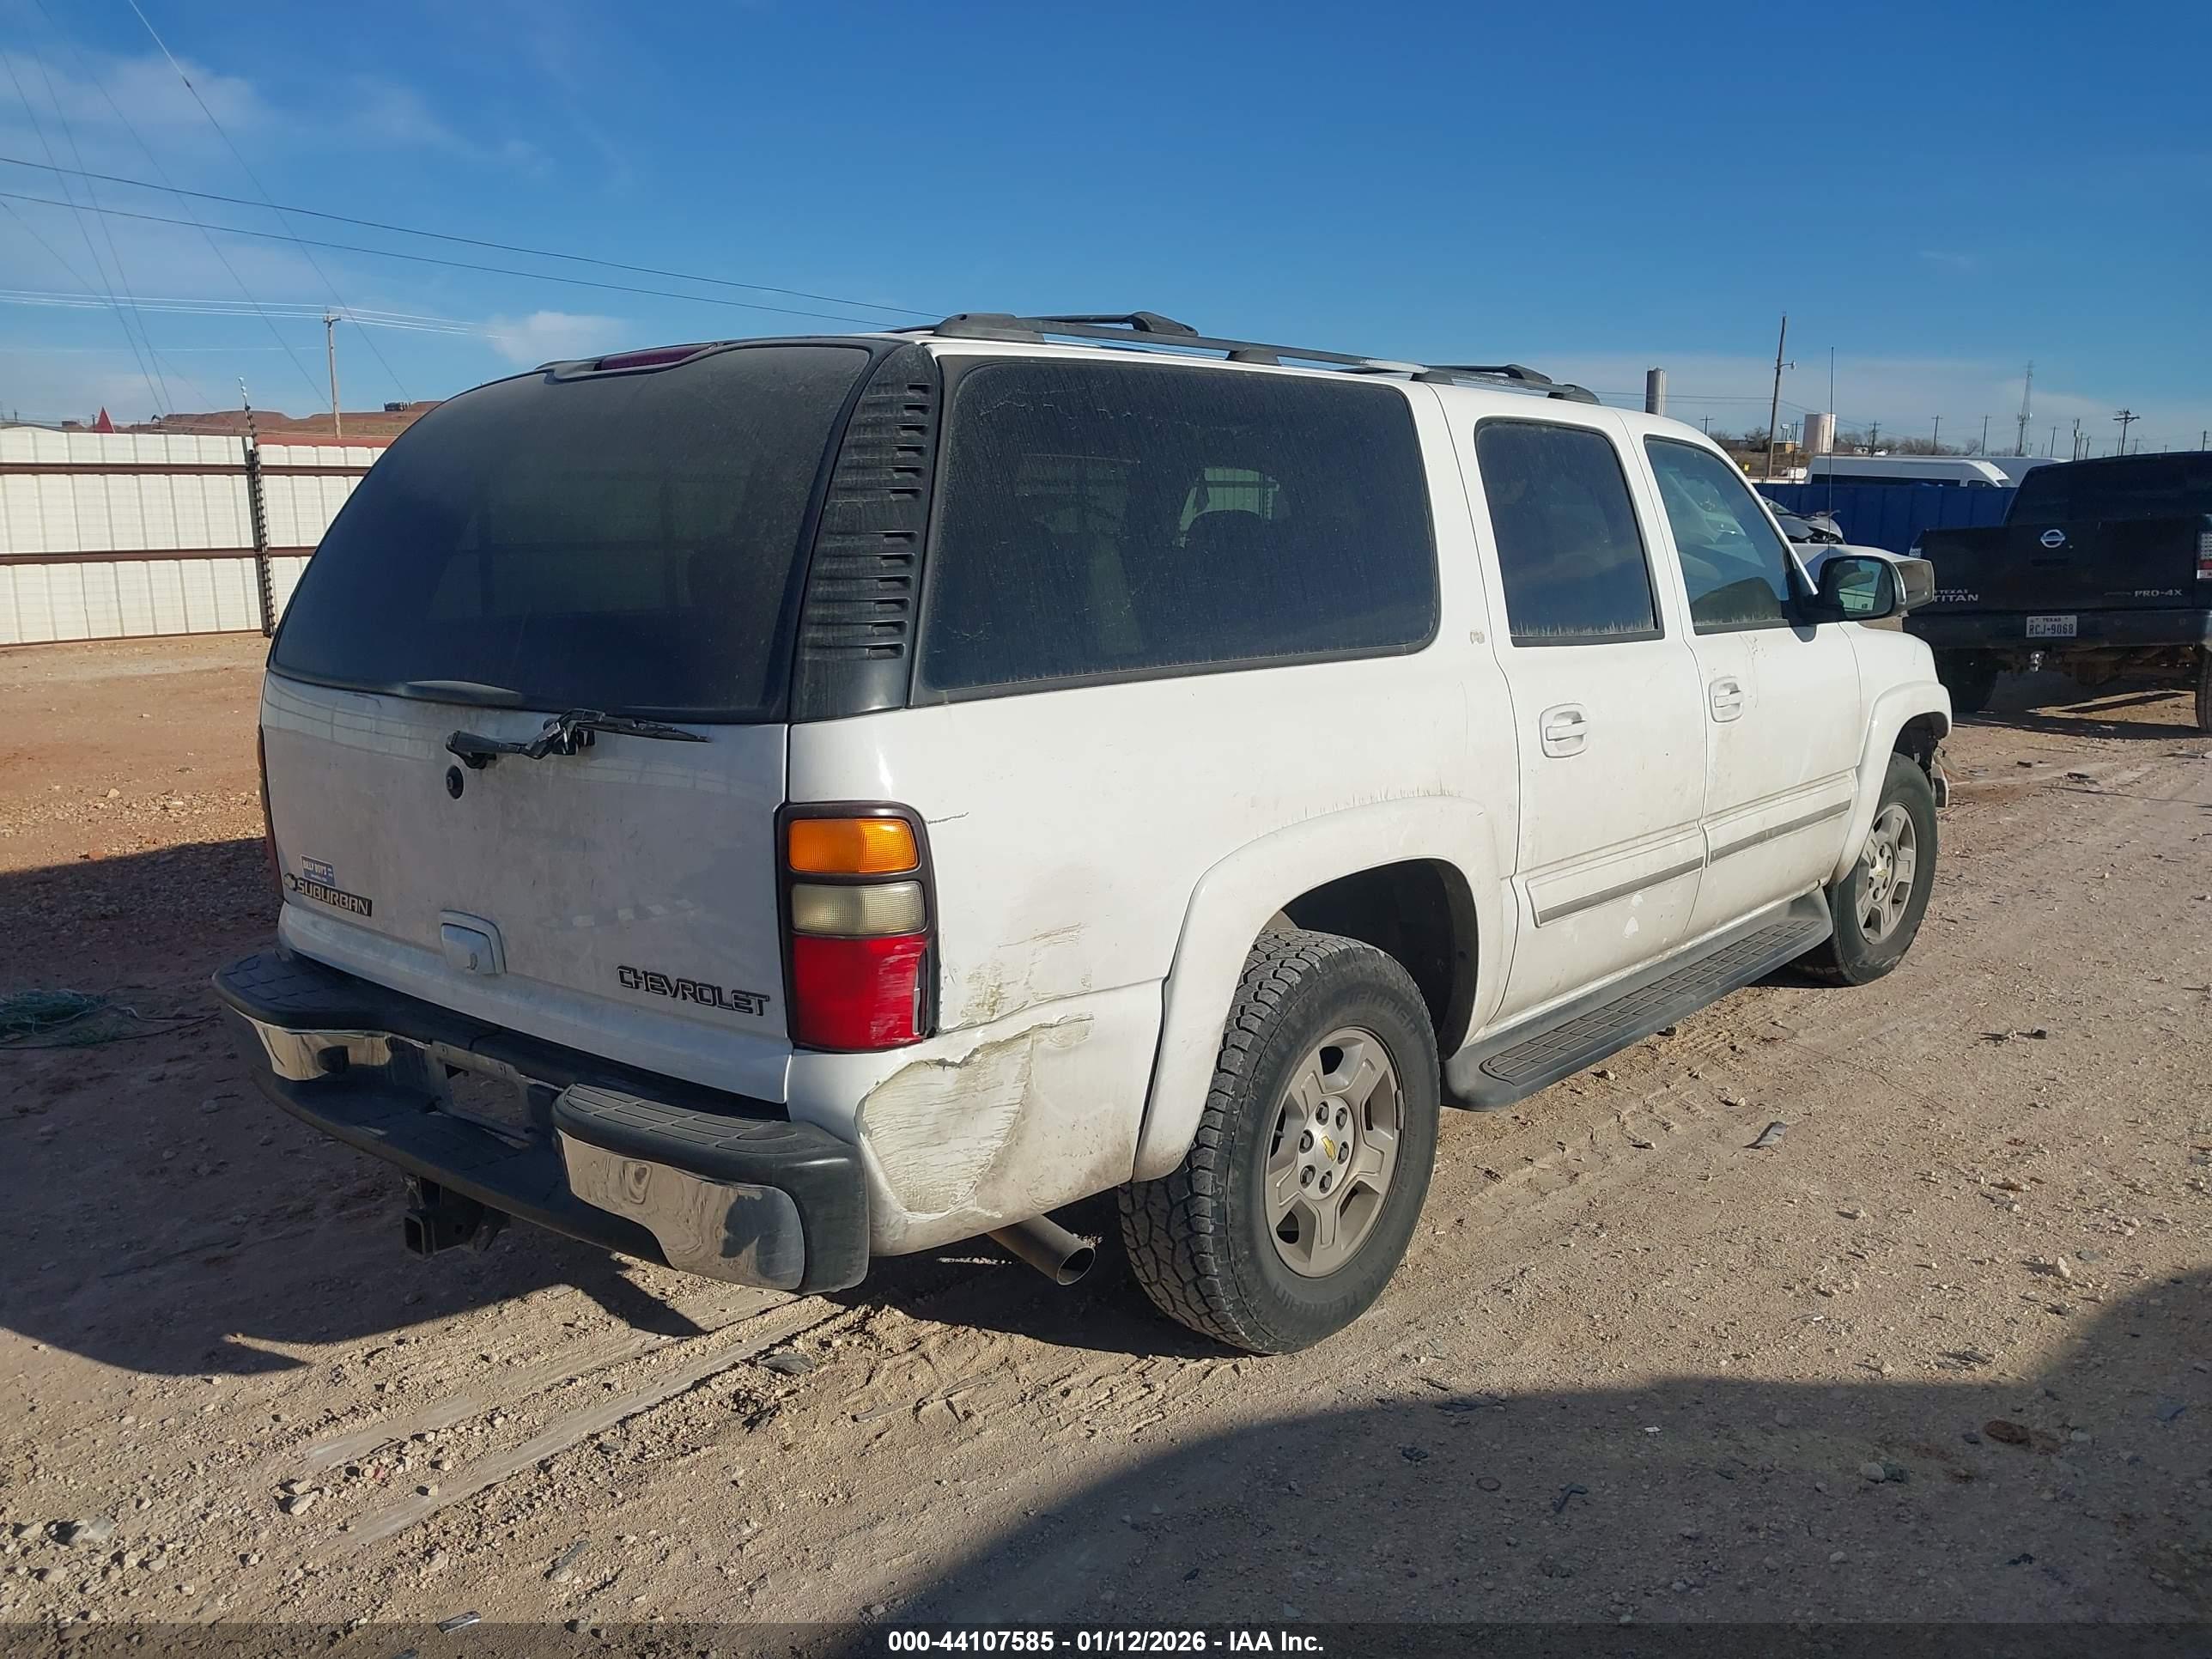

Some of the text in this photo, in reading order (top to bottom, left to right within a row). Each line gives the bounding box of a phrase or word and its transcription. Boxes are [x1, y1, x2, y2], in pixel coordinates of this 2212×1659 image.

[2134, 589, 2183, 598] PRO-4X
[297, 879, 368, 915] SUBURBAN
[617, 965, 770, 1017] CHEVROLET
